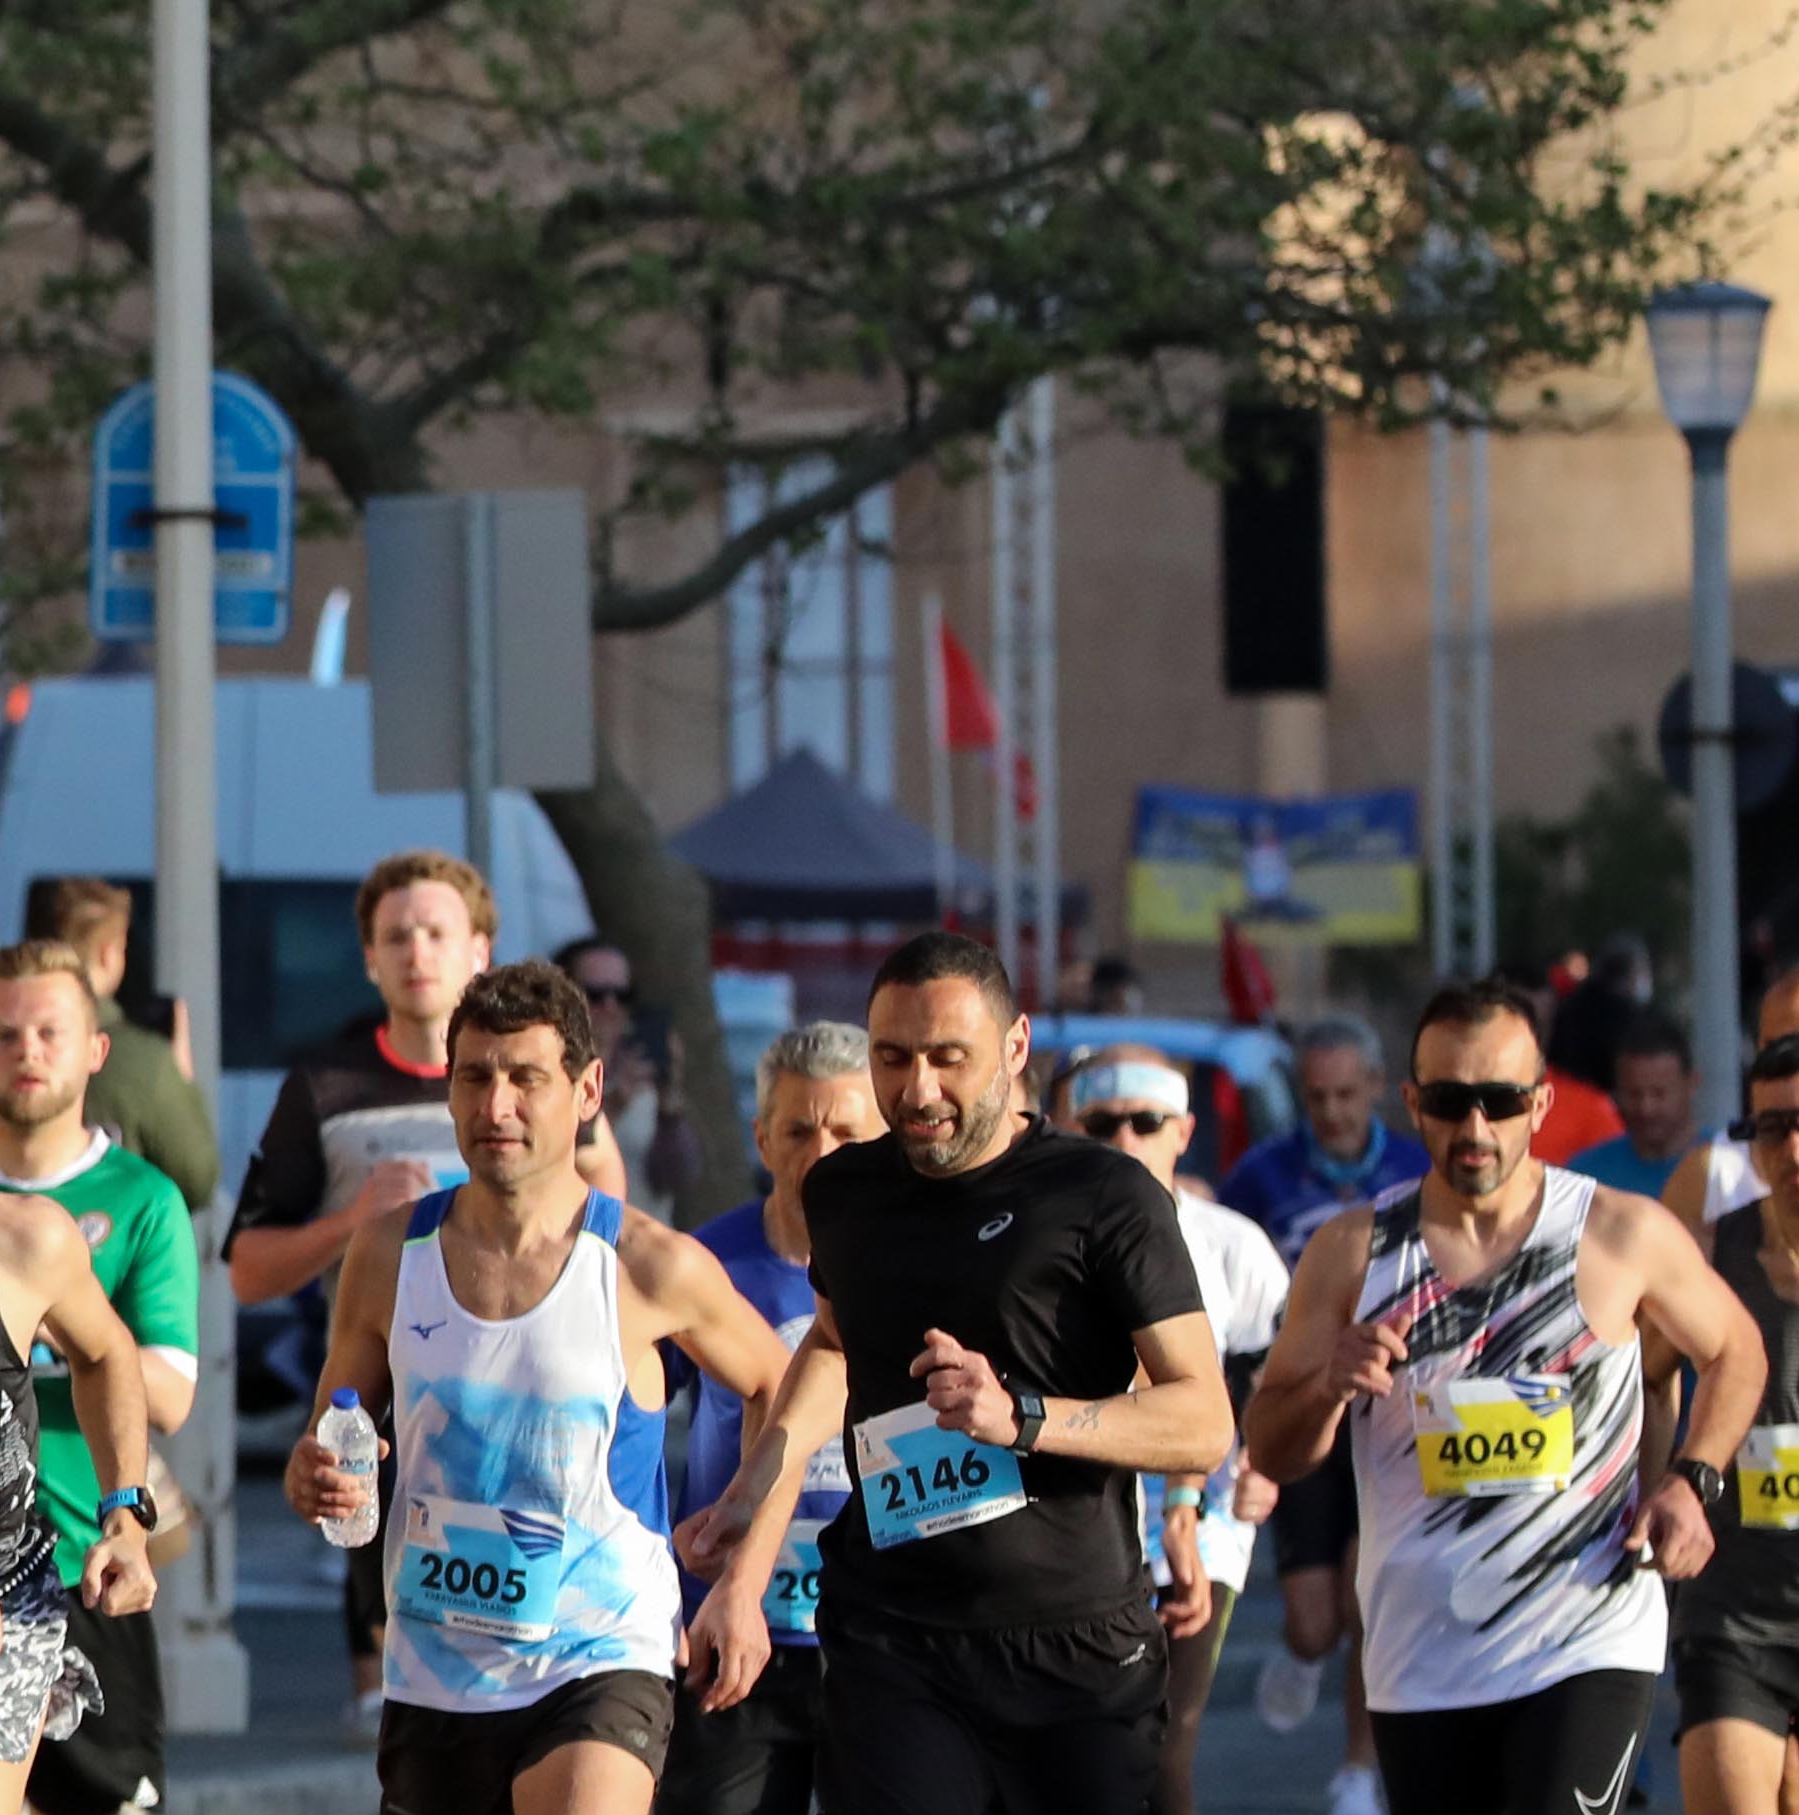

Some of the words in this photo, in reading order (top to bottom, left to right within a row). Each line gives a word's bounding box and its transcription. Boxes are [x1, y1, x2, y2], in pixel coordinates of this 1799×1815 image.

[1439, 1428, 1547, 1467] 4049
[880, 1447, 991, 1513] 2146
[419, 1552, 528, 1604] 2005
